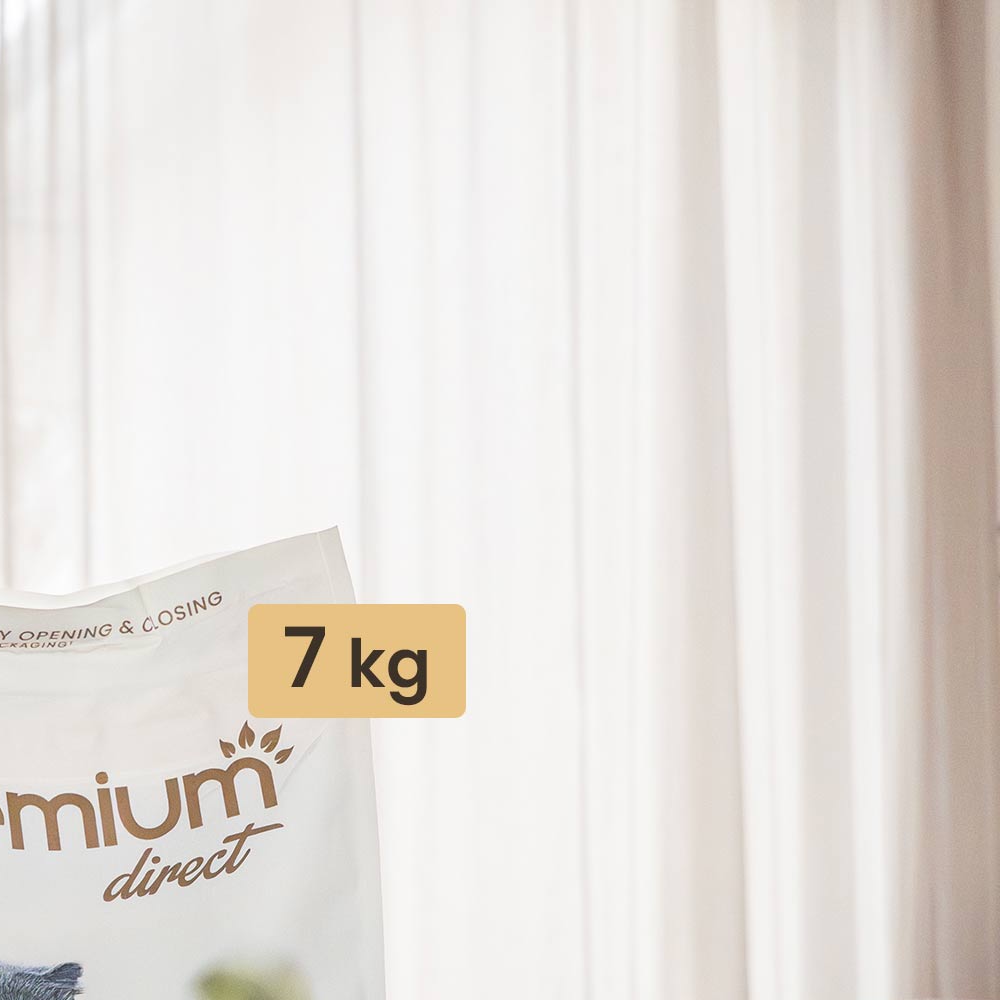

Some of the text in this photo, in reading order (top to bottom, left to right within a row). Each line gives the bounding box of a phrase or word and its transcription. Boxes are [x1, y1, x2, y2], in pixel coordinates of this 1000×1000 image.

[18, 623, 113, 641] OPENING
[119, 620, 134, 634] &
[142, 591, 223, 633] CLOSING
[102, 822, 284, 903] direct
